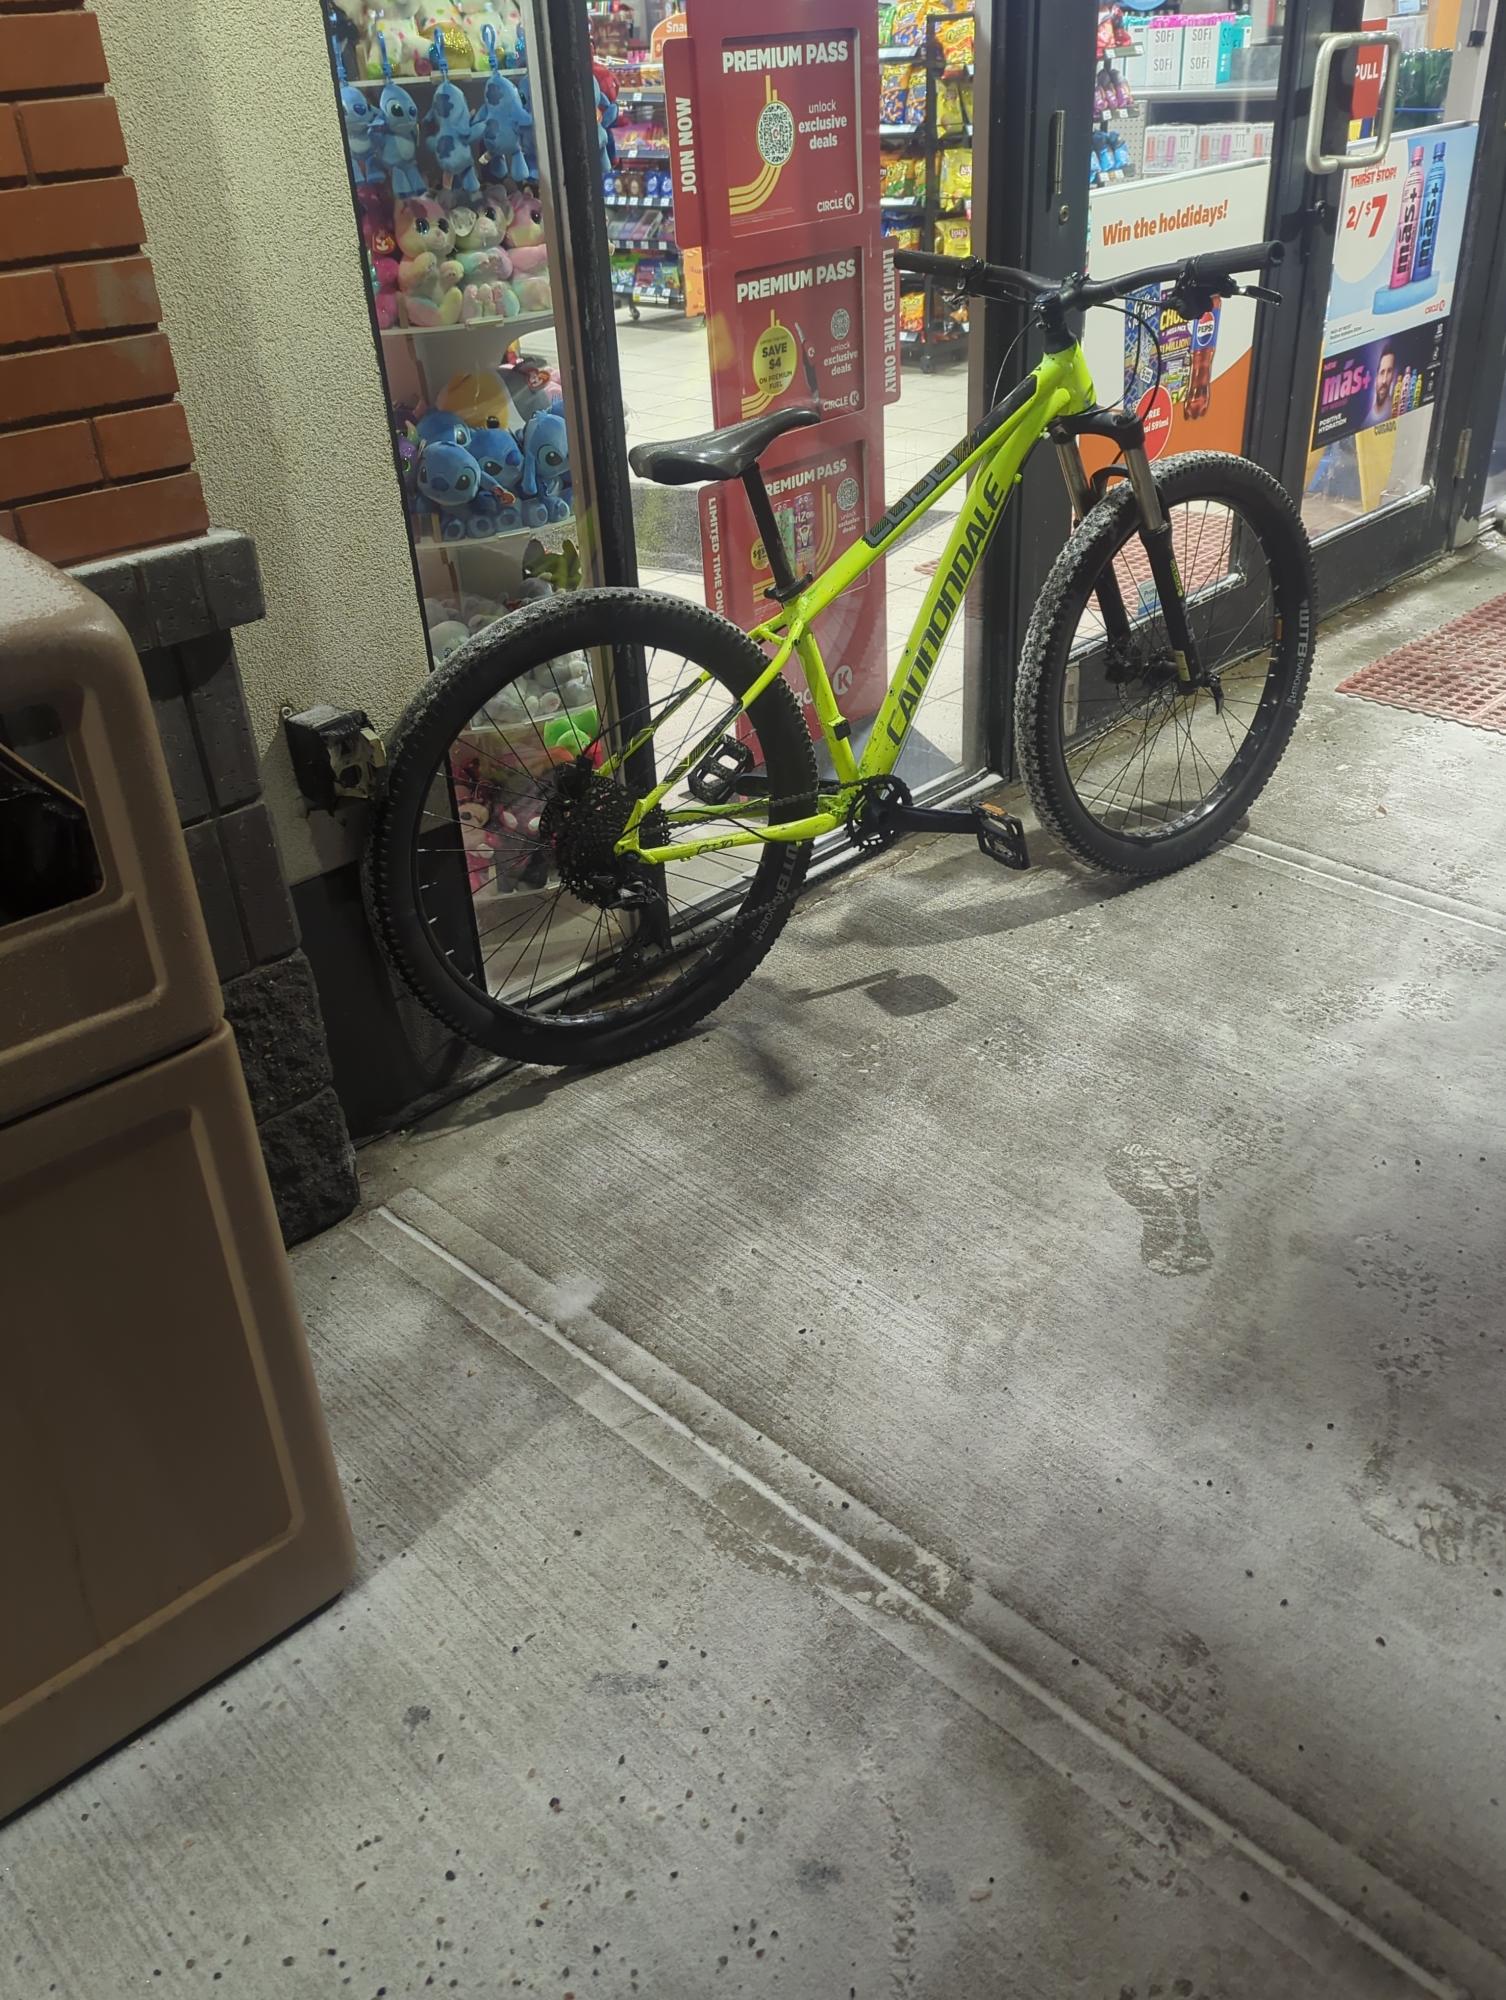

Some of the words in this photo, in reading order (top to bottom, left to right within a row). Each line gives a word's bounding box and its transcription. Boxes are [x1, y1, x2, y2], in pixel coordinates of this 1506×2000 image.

[1155, 30, 1175, 43] SOFi
[1192, 28, 1212, 42] SOFi
[722, 45, 802, 73] PREMIUM
[806, 41, 848, 64] PASS
[1153, 58, 1173, 71] SOFi
[1190, 56, 1210, 70] SOFi
[808, 99, 836, 114] unlock
[676, 97, 694, 146] NOW
[798, 114, 847, 133] exclusive
[809, 133, 838, 150] deals
[680, 151, 697, 195] JOIN
[1351, 171, 1376, 189] THIRST
[1376, 167, 1397, 183] STOP!
[817, 198, 843, 213] CIRCLE
[844, 192, 855, 210] K
[1102, 220, 1130, 246] Win
[1133, 217, 1156, 239] the
[1158, 200, 1228, 234] holdidays!
[737, 268, 813, 303] PREMIUM
[816, 259, 856, 284] PASS
[883, 249, 895, 312] LIMITED
[884, 315, 896, 352] TIME
[762, 342, 788, 358] SAVE
[824, 349, 858, 366] exclusive
[831, 343, 850, 353] unlock
[769, 357, 782, 370] $4
[831, 363, 852, 376] deals
[759, 377, 768, 385] ON
[768, 370, 793, 382] PREMIUM
[885, 357, 897, 393] ONLY
[770, 381, 783, 390] FUEL
[823, 395, 848, 411] CIRCLE
[765, 469, 815, 497] REMIUM
[816, 458, 847, 480] PASS
[709, 497, 720, 553] LIMITED
[713, 554, 723, 589] TIME
[886, 471, 1005, 747] CANNONDALE
[1297, 609, 1309, 657] WTB
